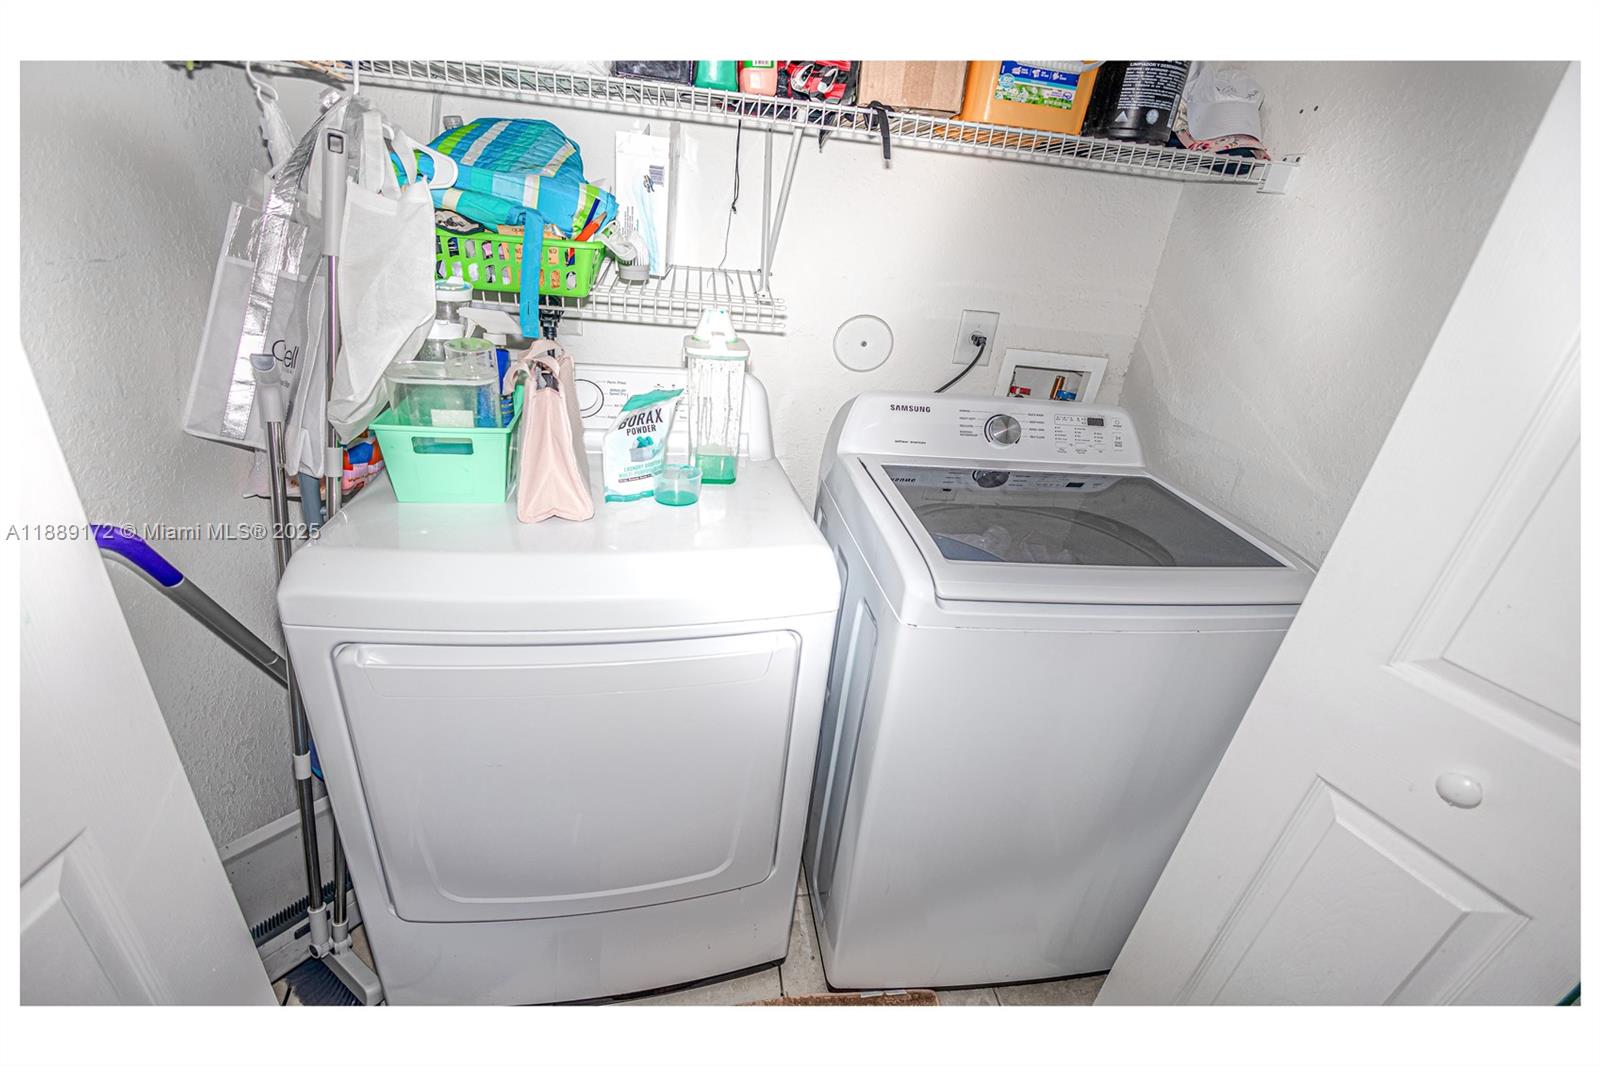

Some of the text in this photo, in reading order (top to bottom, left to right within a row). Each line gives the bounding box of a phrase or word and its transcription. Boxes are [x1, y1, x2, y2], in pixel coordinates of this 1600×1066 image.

[890, 404, 931, 413] SAMSUNG
[618, 408, 663, 430] BORAX
[626, 424, 657, 436] POWDER
